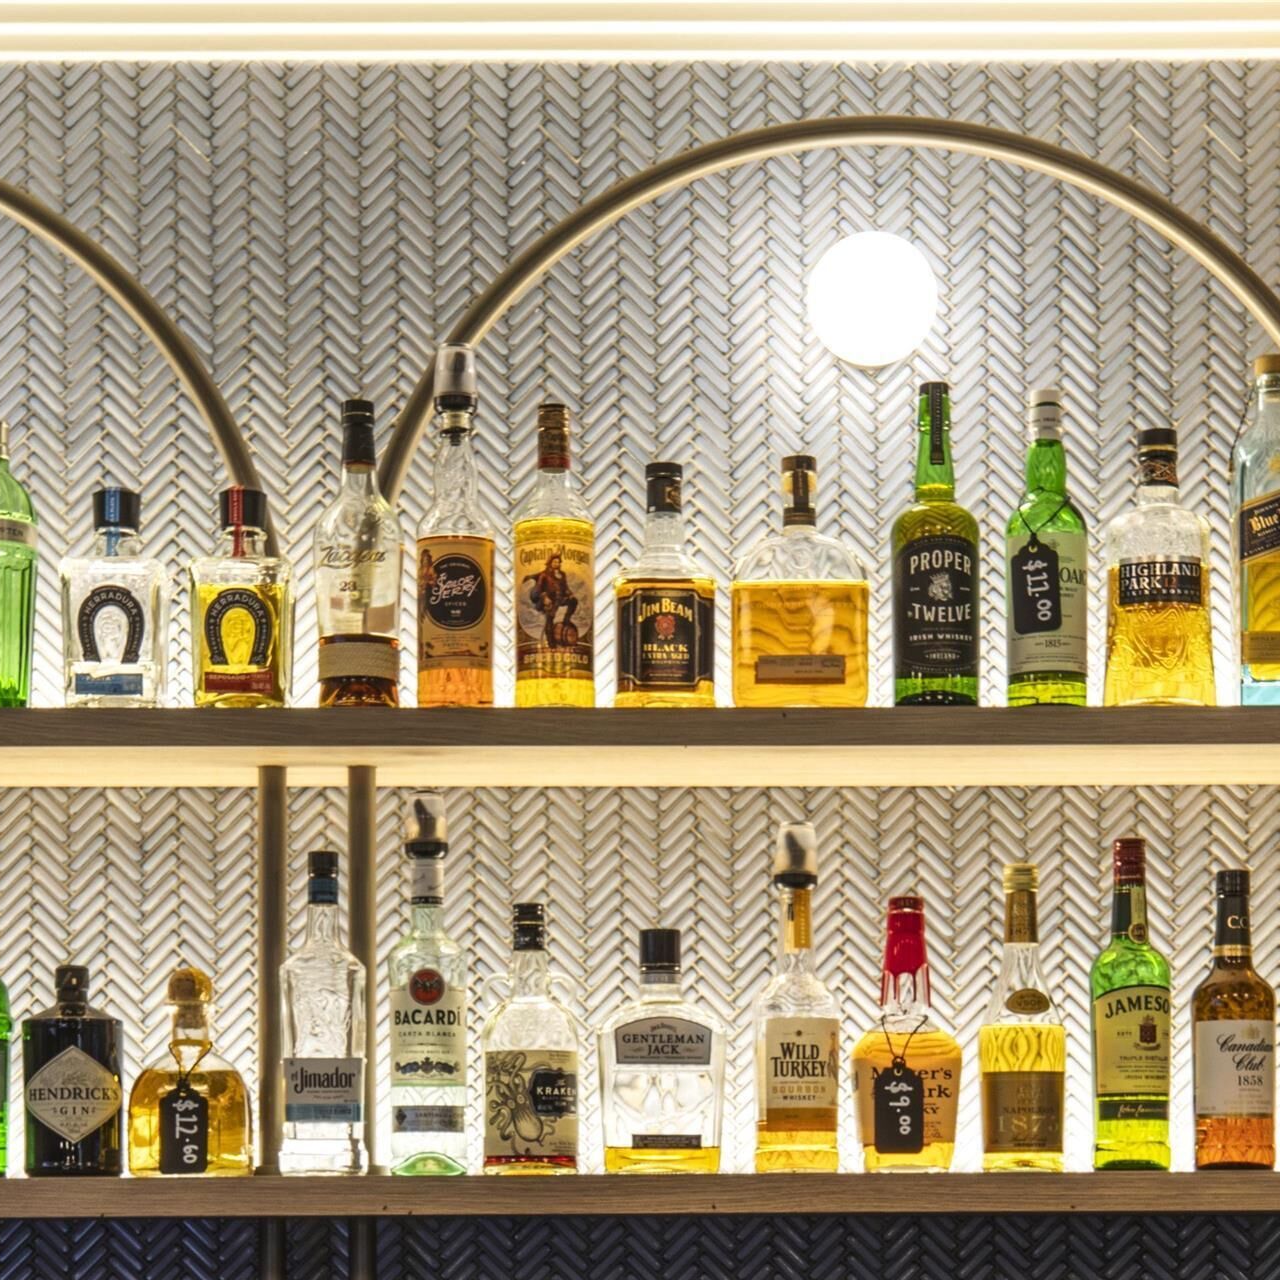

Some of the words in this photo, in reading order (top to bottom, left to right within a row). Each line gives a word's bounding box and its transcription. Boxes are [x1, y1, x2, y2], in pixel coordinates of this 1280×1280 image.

[1248, 509, 1280, 534] Blue
[520, 545, 552, 567] Captain
[553, 544, 591, 566] Morgan
[910, 549, 972, 576] PROPER
[1120, 563, 1201, 579] HIGHLAND
[1022, 559, 1052, 621] $11.00
[1120, 575, 1162, 590] PARK
[83, 590, 139, 616] HERRADURA
[210, 593, 265, 619] HERRADURA
[911, 602, 971, 623] TWELVE
[622, 1033, 705, 1044] GENTLEMAN
[646, 1044, 681, 1056] JACK
[780, 1042, 820, 1059] WILD
[770, 1057, 828, 1079] TURKEY
[1232, 1053, 1265, 1071] Club
[294, 1066, 356, 1095] Jimador
[1237, 1075, 1264, 1087] 1858
[884, 1081, 914, 1136] $9.00
[172, 1099, 200, 1165] $12.60
